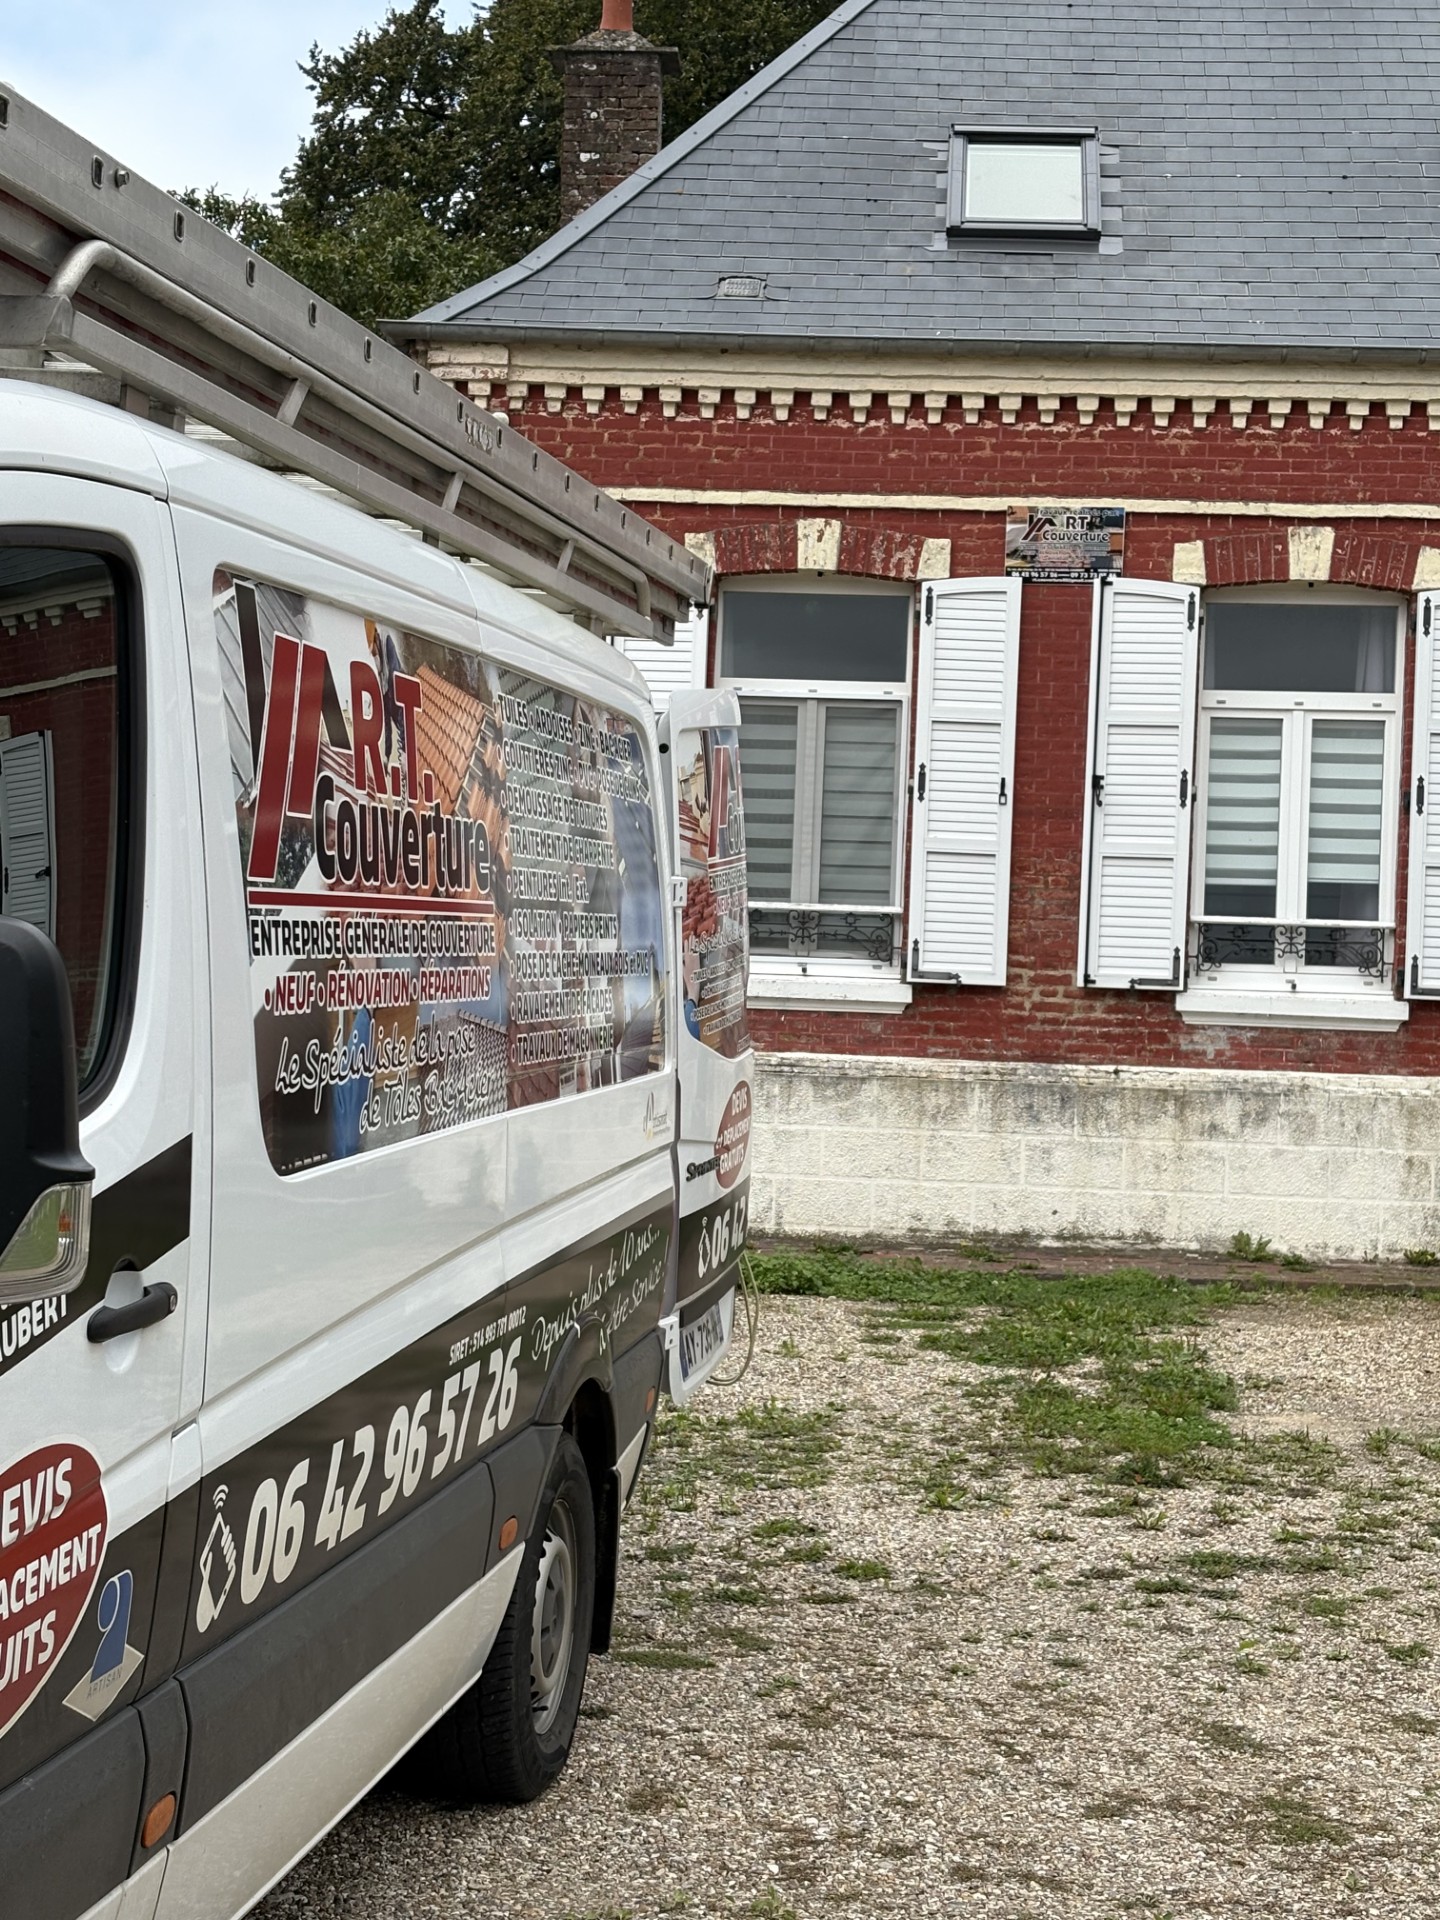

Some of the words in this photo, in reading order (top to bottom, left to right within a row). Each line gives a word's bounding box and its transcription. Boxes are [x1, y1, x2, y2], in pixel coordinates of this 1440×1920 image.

[1042, 530, 1109, 542] Couverture
[498, 693, 529, 731] TUILES
[535, 706, 574, 745] ARDOISES
[555, 753, 574, 786] ZINC
[506, 777, 563, 824] DÉMOUSSAGE
[315, 771, 491, 894] Couverture
[509, 825, 563, 863] TRAITEMENT
[574, 835, 615, 870] CHARPENTE
[512, 866, 558, 900] PEINTURES
[250, 916, 342, 958] ENTREPRISE
[344, 911, 410, 958] GÉNÉRALE
[411, 919, 428, 957] DE
[429, 920, 496, 957] COUVERTURE
[513, 908, 558, 941] ISOLATION
[274, 971, 316, 1016] NEUF
[327, 960, 411, 1011] RÉNOVATION
[419, 959, 491, 1004] RÉPARATIONS
[515, 950, 537, 981] POSE
[537, 950, 550, 980] DE
[275, 1037, 301, 1094] Le
[302, 1018, 408, 1115] Spécialiste
[359, 1081, 381, 1134] de
[711, 1208, 730, 1270] 06
[531, 1290, 578, 1372] Depuis
[603, 1248, 618, 1293] de
[619, 1230, 635, 1277] 10
[241, 1458, 310, 1604] 06
[314, 1424, 375, 1551] 42
[377, 1389, 432, 1517] 96
[430, 1360, 481, 1480] 57
[477, 1335, 522, 1446] 26
